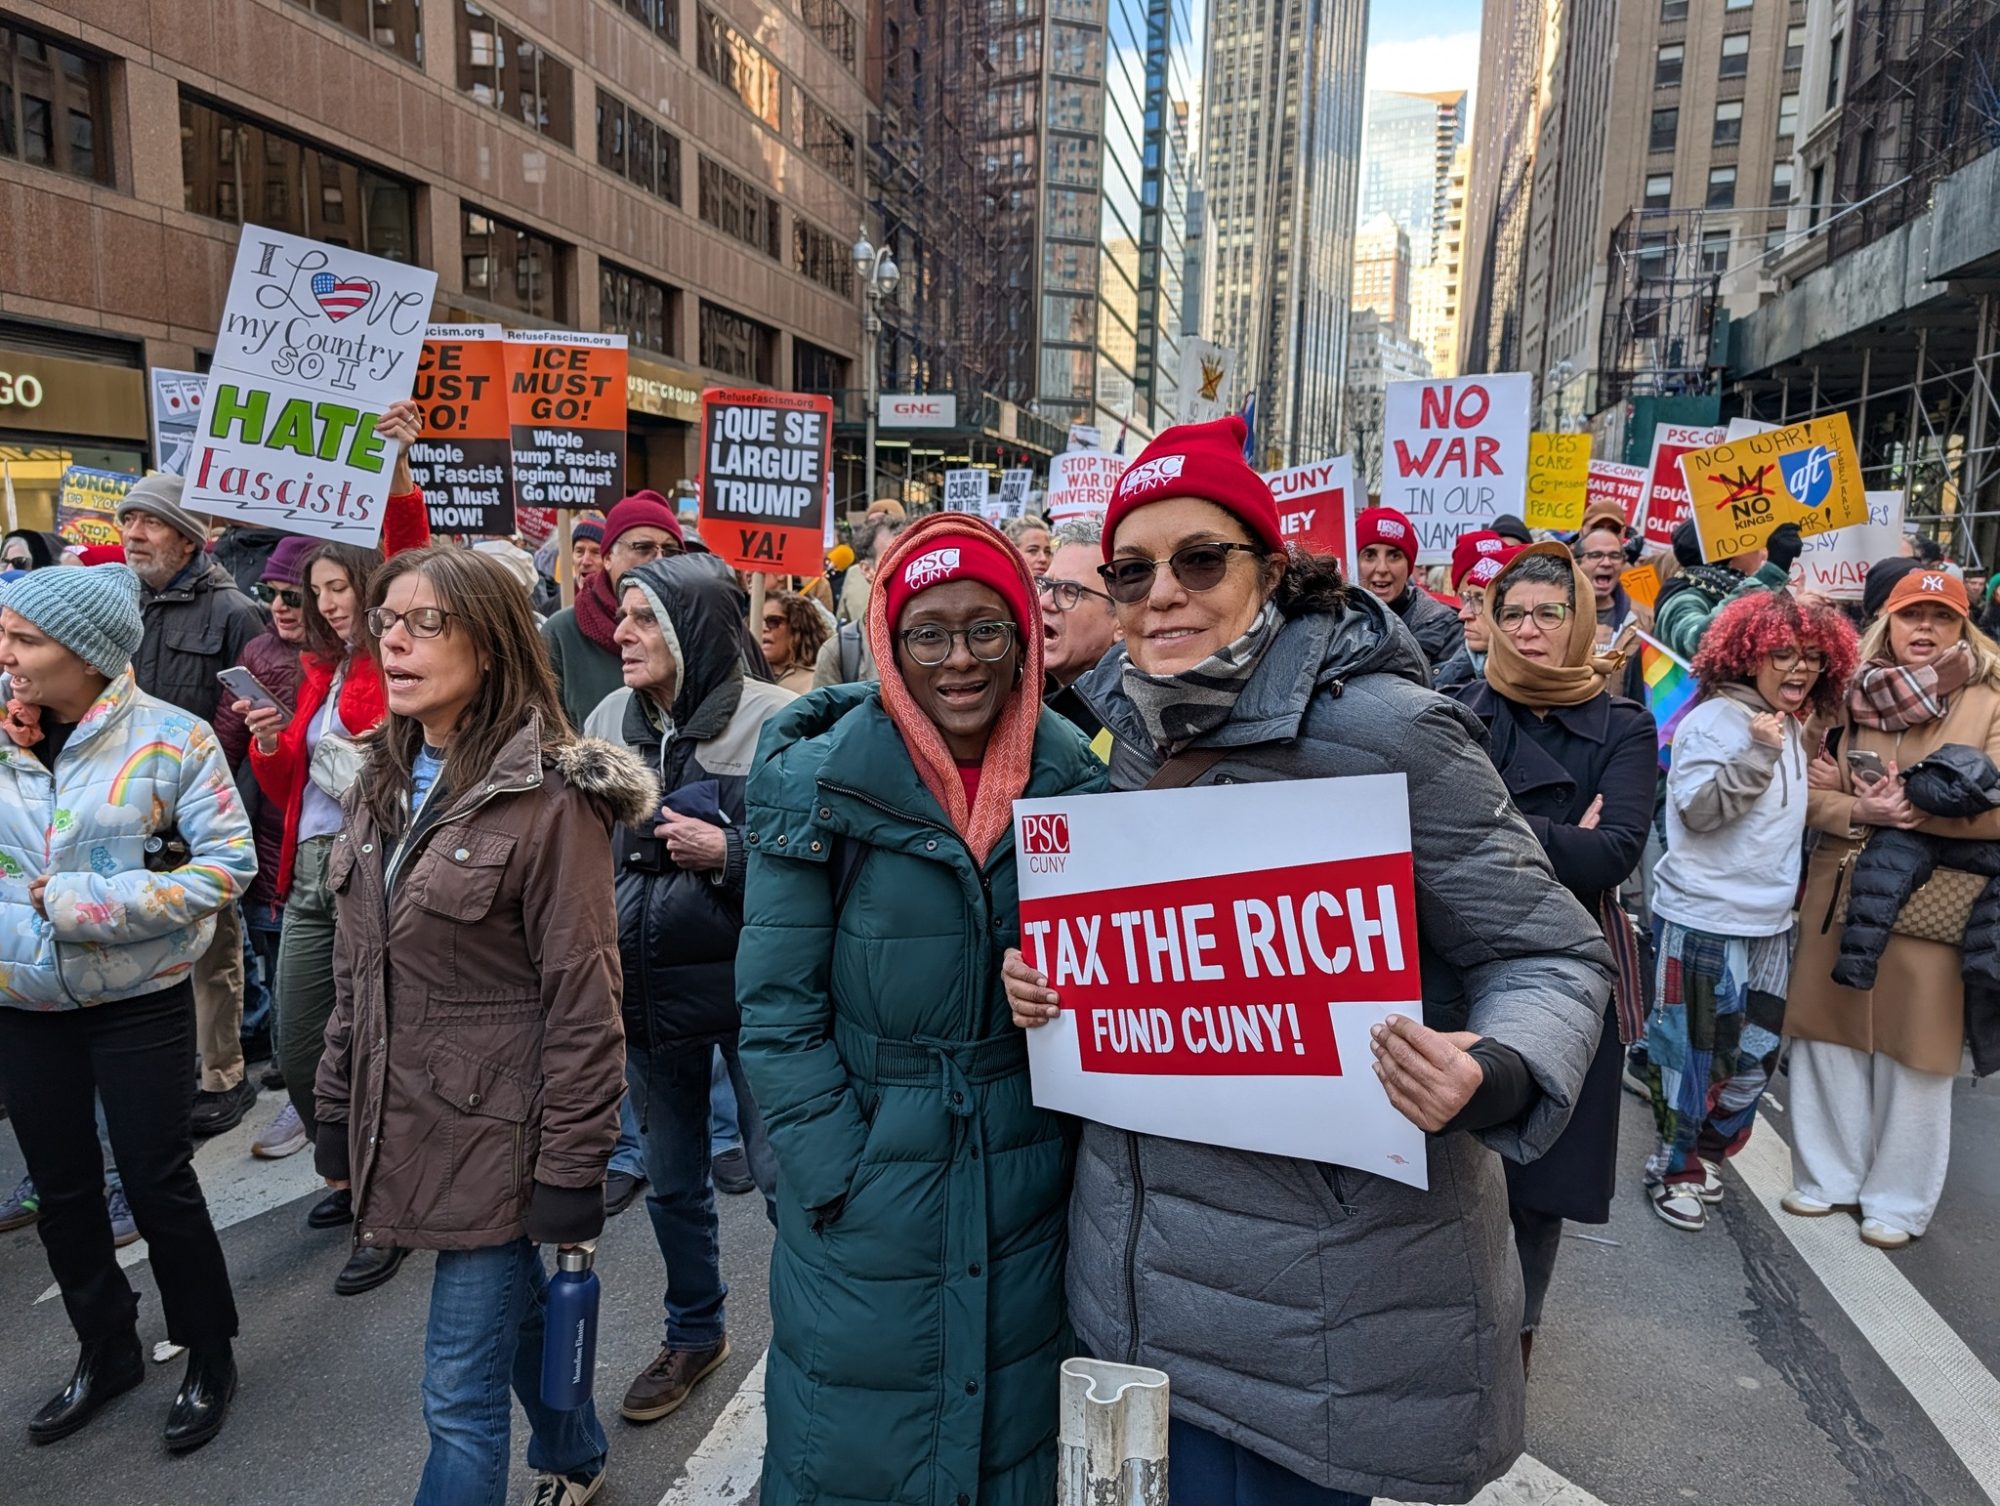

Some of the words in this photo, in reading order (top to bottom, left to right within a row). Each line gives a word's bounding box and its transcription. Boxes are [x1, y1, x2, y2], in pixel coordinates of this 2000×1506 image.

[251, 241, 284, 277] I
[226, 313, 280, 354] my
[285, 317, 404, 380] Country
[507, 330, 612, 346] RefuseFascism.org
[271, 346, 325, 379] SO
[330, 358, 360, 390] I
[418, 344, 463, 371] CE
[532, 348, 591, 371] ICE
[412, 375, 490, 401] UST
[512, 373, 612, 397] MUST
[628, 376, 657, 396] USIC
[660, 384, 697, 405] GROUP
[530, 398, 592, 421] GO!
[719, 391, 814, 409] RefuseFascism.org
[894, 404, 940, 414] GNC
[1420, 384, 1490, 429] NO
[210, 384, 386, 474] HATE
[714, 407, 776, 443] ¡QUE
[784, 412, 820, 446] SE
[533, 430, 583, 449] Whole
[1546, 433, 1576, 453] YES
[1695, 446, 1735, 471] NO
[1750, 423, 1812, 454] WAR!
[409, 443, 464, 463] Whole
[512, 450, 551, 467] rump
[555, 448, 617, 468] Fascist
[710, 443, 818, 482] LARGUE
[1393, 436, 1504, 478] WAR
[1535, 455, 1573, 470] CARE
[434, 464, 504, 484] Fascist
[570, 468, 612, 486] Must
[1061, 457, 1096, 473] STOP
[1100, 458, 1125, 474] THE
[1123, 456, 1182, 490] PSC
[1591, 462, 1644, 478] PSC-CUNY
[1790, 445, 1836, 503] aft
[194, 447, 375, 521] Fascists
[948, 481, 982, 499] CUBA!
[1067, 475, 1099, 488] WAR
[1124, 477, 1173, 501] CUNY
[1587, 479, 1615, 493] SAVE
[1618, 483, 1640, 497] THE
[453, 486, 500, 506] Must
[522, 485, 545, 501] Go
[548, 485, 596, 504] NOW!
[714, 480, 812, 518] TRUMP
[1049, 488, 1113, 507] UNIVERSI
[1404, 488, 1434, 515] IN
[1444, 487, 1495, 515] OUR
[429, 507, 484, 527] NOW!
[1531, 500, 1574, 519] PEACE
[1731, 497, 1771, 521] NO
[80, 524, 111, 538] STOP
[1716, 534, 1758, 558] NO
[1799, 507, 1834, 533] AR!
[1735, 513, 1775, 530] KINGS
[739, 529, 788, 561] YA!
[907, 549, 957, 579] PSC
[910, 568, 953, 590] CUNY
[1921, 575, 1945, 591] NY
[1022, 814, 1070, 854] PSC
[1030, 856, 1066, 873] CUNY
[1025, 915, 1109, 986] TAX
[1112, 903, 1225, 985] THE
[1233, 884, 1406, 979] RICH
[1092, 1007, 1174, 1054] FUND
[1181, 1003, 1305, 1055] CUNY!
